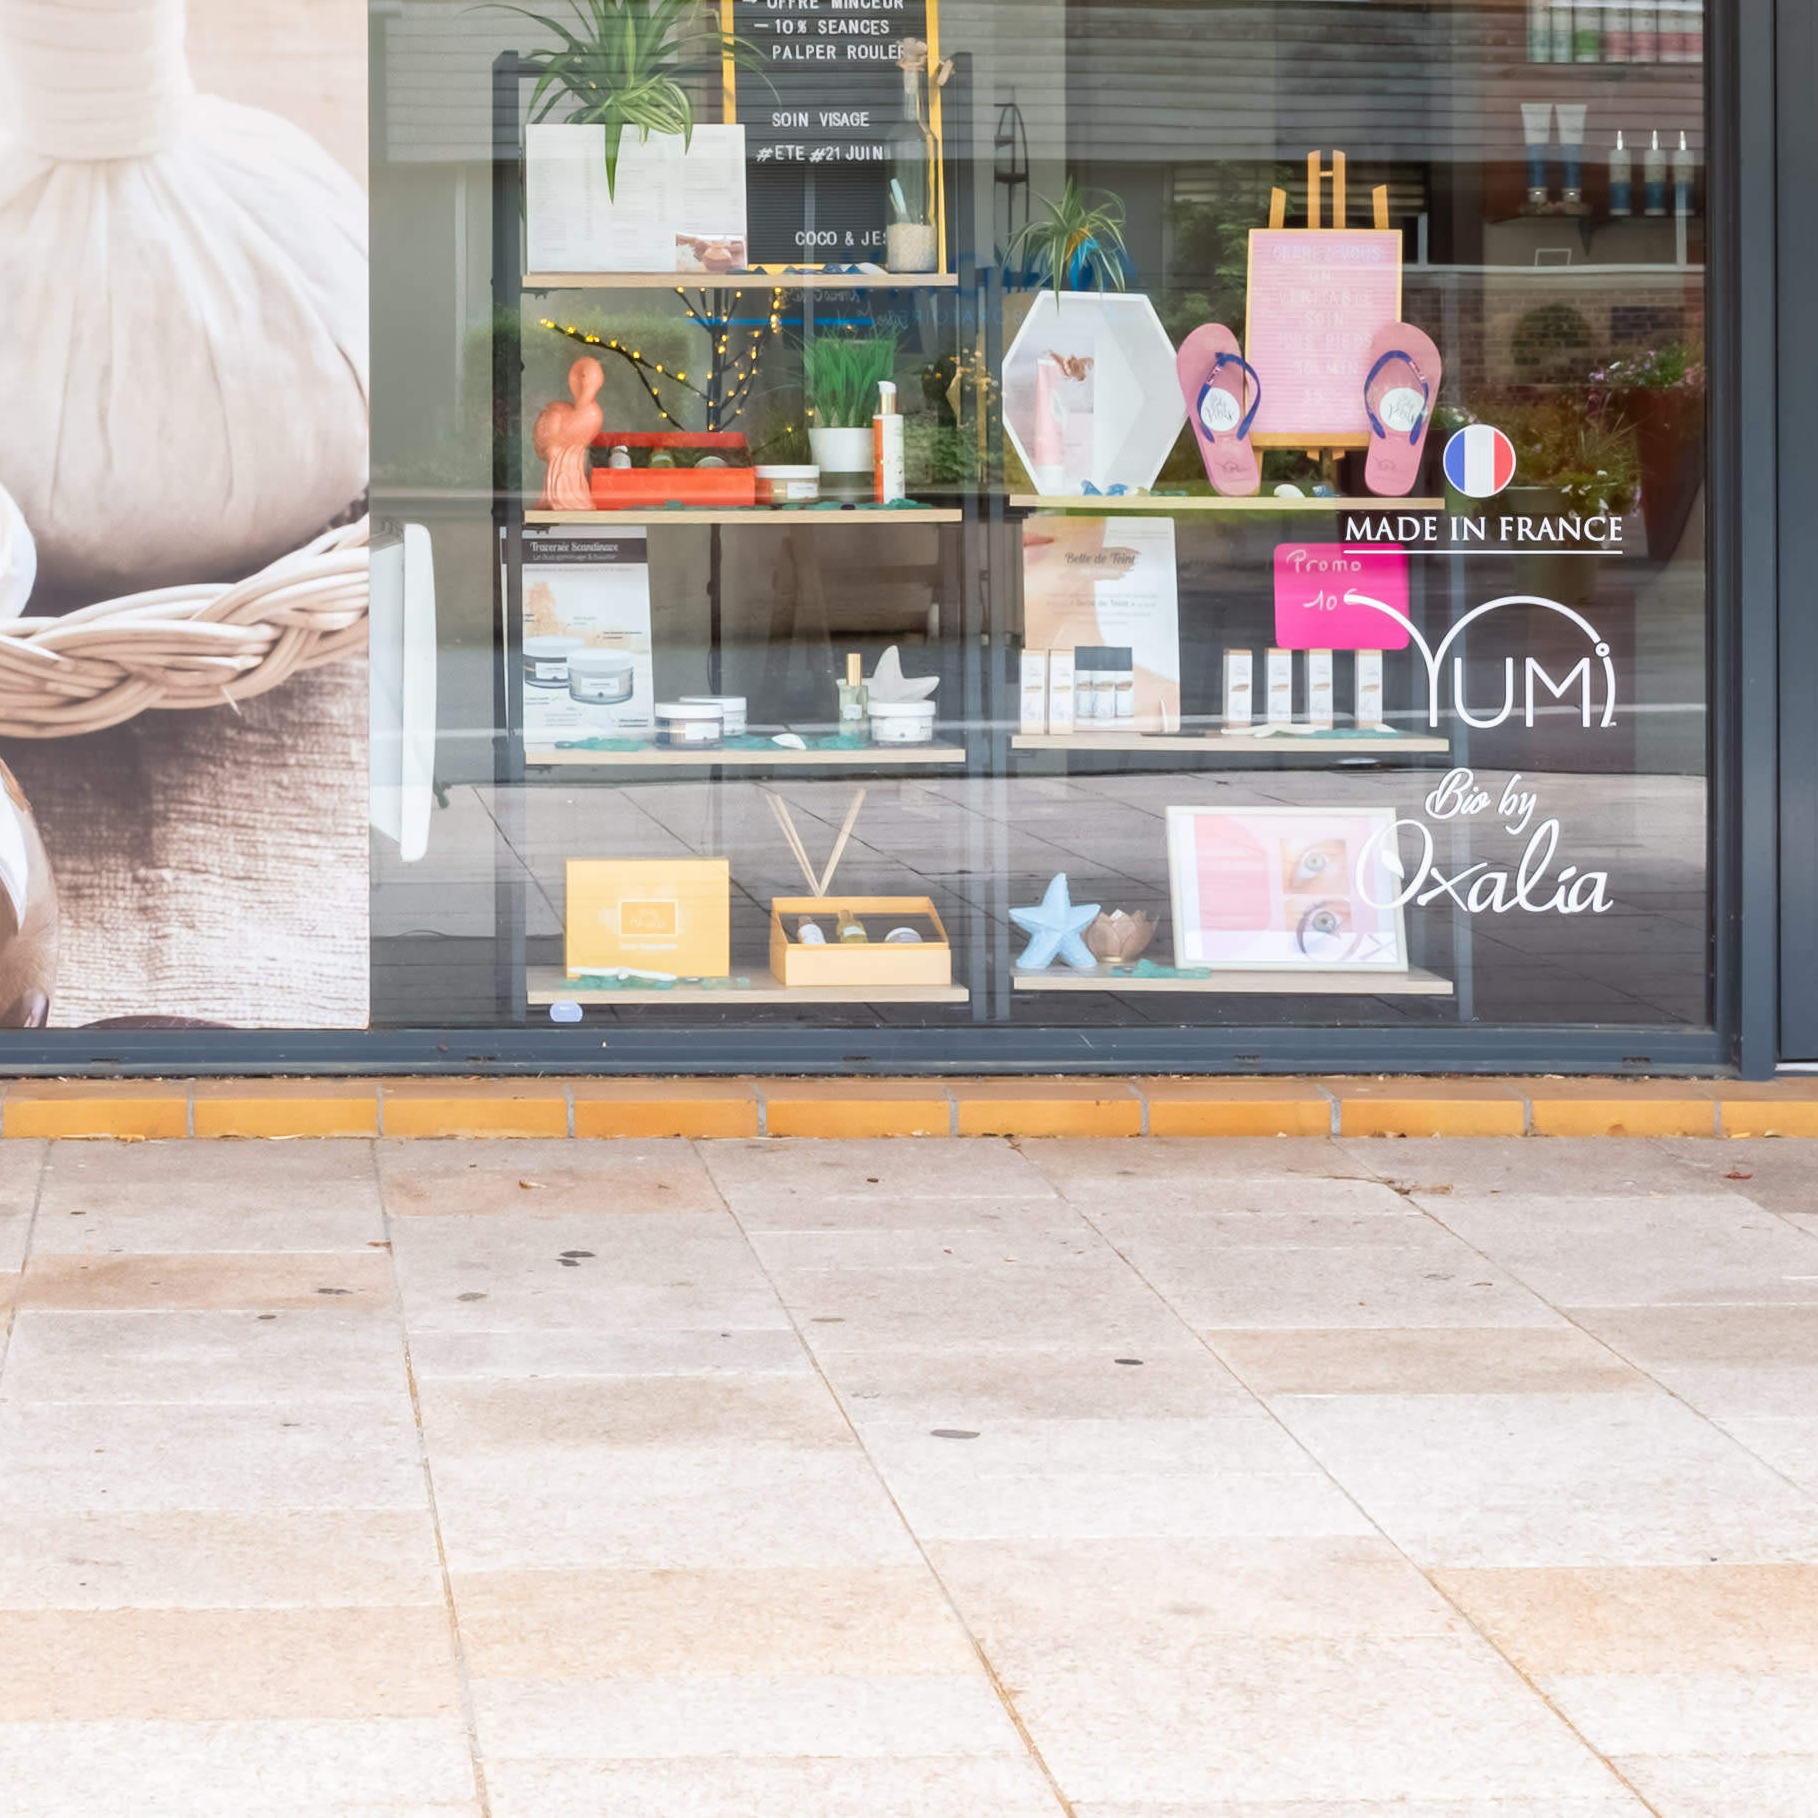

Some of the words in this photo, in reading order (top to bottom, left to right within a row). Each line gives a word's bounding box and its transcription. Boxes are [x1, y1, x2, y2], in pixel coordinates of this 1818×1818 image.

[818, 20, 890, 35] SEANCES
[772, 45, 837, 60] PALPER
[772, 112, 809, 128] SOIN
[819, 112, 870, 127] VISAGE
[795, 231, 838, 246] COCO
[845, 231, 855, 246] &
[1344, 516, 1437, 542] MADE
[1450, 516, 1486, 542] IN
[1500, 516, 1623, 542] FRANCE
[1065, 552, 1091, 564] Belle
[1094, 553, 1108, 564] de
[1285, 549, 1362, 574] Promo
[1425, 767, 1492, 820] Bio
[1497, 773, 1537, 835] by
[1355, 818, 1613, 914] Oxalia
